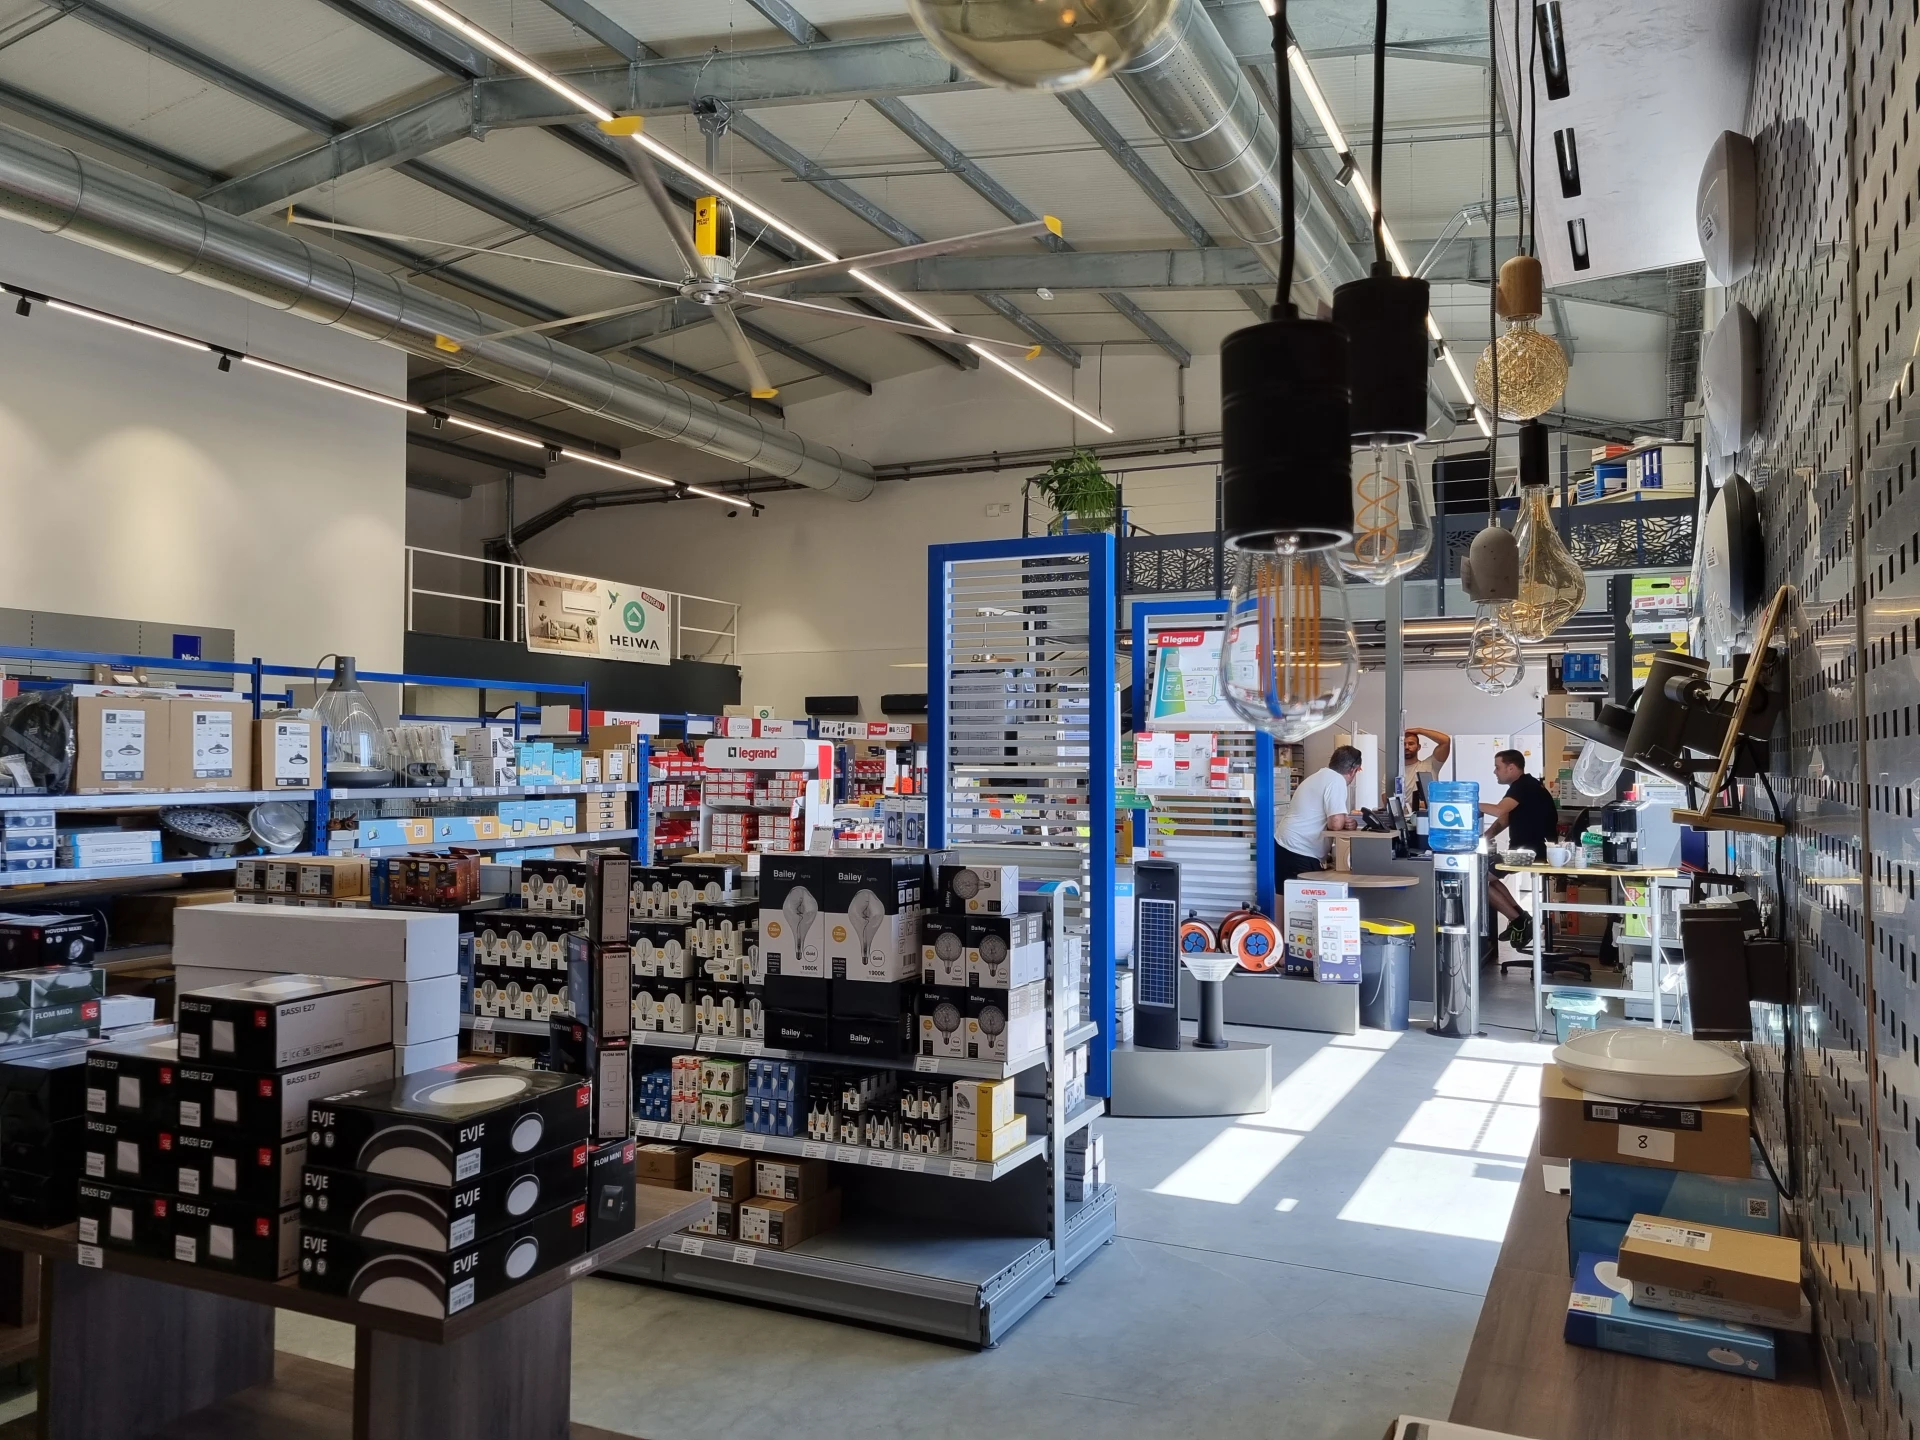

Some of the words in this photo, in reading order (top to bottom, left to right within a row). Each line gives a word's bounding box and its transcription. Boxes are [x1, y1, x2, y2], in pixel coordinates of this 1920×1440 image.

[610, 634, 660, 650] HEIWA
[1170, 636, 1199, 645] legrand
[618, 719, 640, 727] legrand
[768, 726, 782, 734] legrand
[739, 747, 777, 761] legrand
[773, 870, 796, 880] Bailey
[838, 872, 862, 883] Bailey
[181, 1002, 199, 1011] BASSI
[201, 1004, 212, 1012] E27
[281, 1007, 301, 1016] BASSI
[303, 1004, 316, 1012] E27
[35, 1010, 55, 1020] FLOM
[86, 1008, 98, 1018] sg
[575, 1031, 582, 1041] sg
[781, 1028, 800, 1038] Bailey
[850, 1034, 870, 1044] Bailey
[88, 1058, 105, 1068] BASSI
[107, 1061, 118, 1069] E27
[181, 1070, 199, 1079] BASSI
[201, 1073, 213, 1081] E27
[286, 1075, 306, 1085] BASSI
[308, 1072, 320, 1080] E27
[580, 1093, 589, 1104] sg
[311, 1110, 335, 1127] EVJE
[88, 1122, 104, 1132] BASSI
[460, 1123, 485, 1142] EVJE
[180, 1136, 199, 1146] BASSI
[200, 1140, 213, 1148] E27
[1638, 1135, 1648, 1148] 8
[285, 1144, 302, 1155] BASS
[577, 1151, 586, 1164] sg
[594, 1155, 609, 1167] FLOM
[610, 1151, 622, 1162] MINI
[626, 1149, 634, 1162] sg
[304, 1173, 328, 1190] EVJE
[81, 1187, 99, 1197] BASSI
[100, 1191, 111, 1200] E27
[455, 1188, 480, 1208] EVJE
[176, 1203, 195, 1214] BASSI
[197, 1207, 210, 1216] E27
[576, 1212, 584, 1223] sg
[303, 1236, 328, 1254] EVJE
[453, 1252, 478, 1274] EVJE
